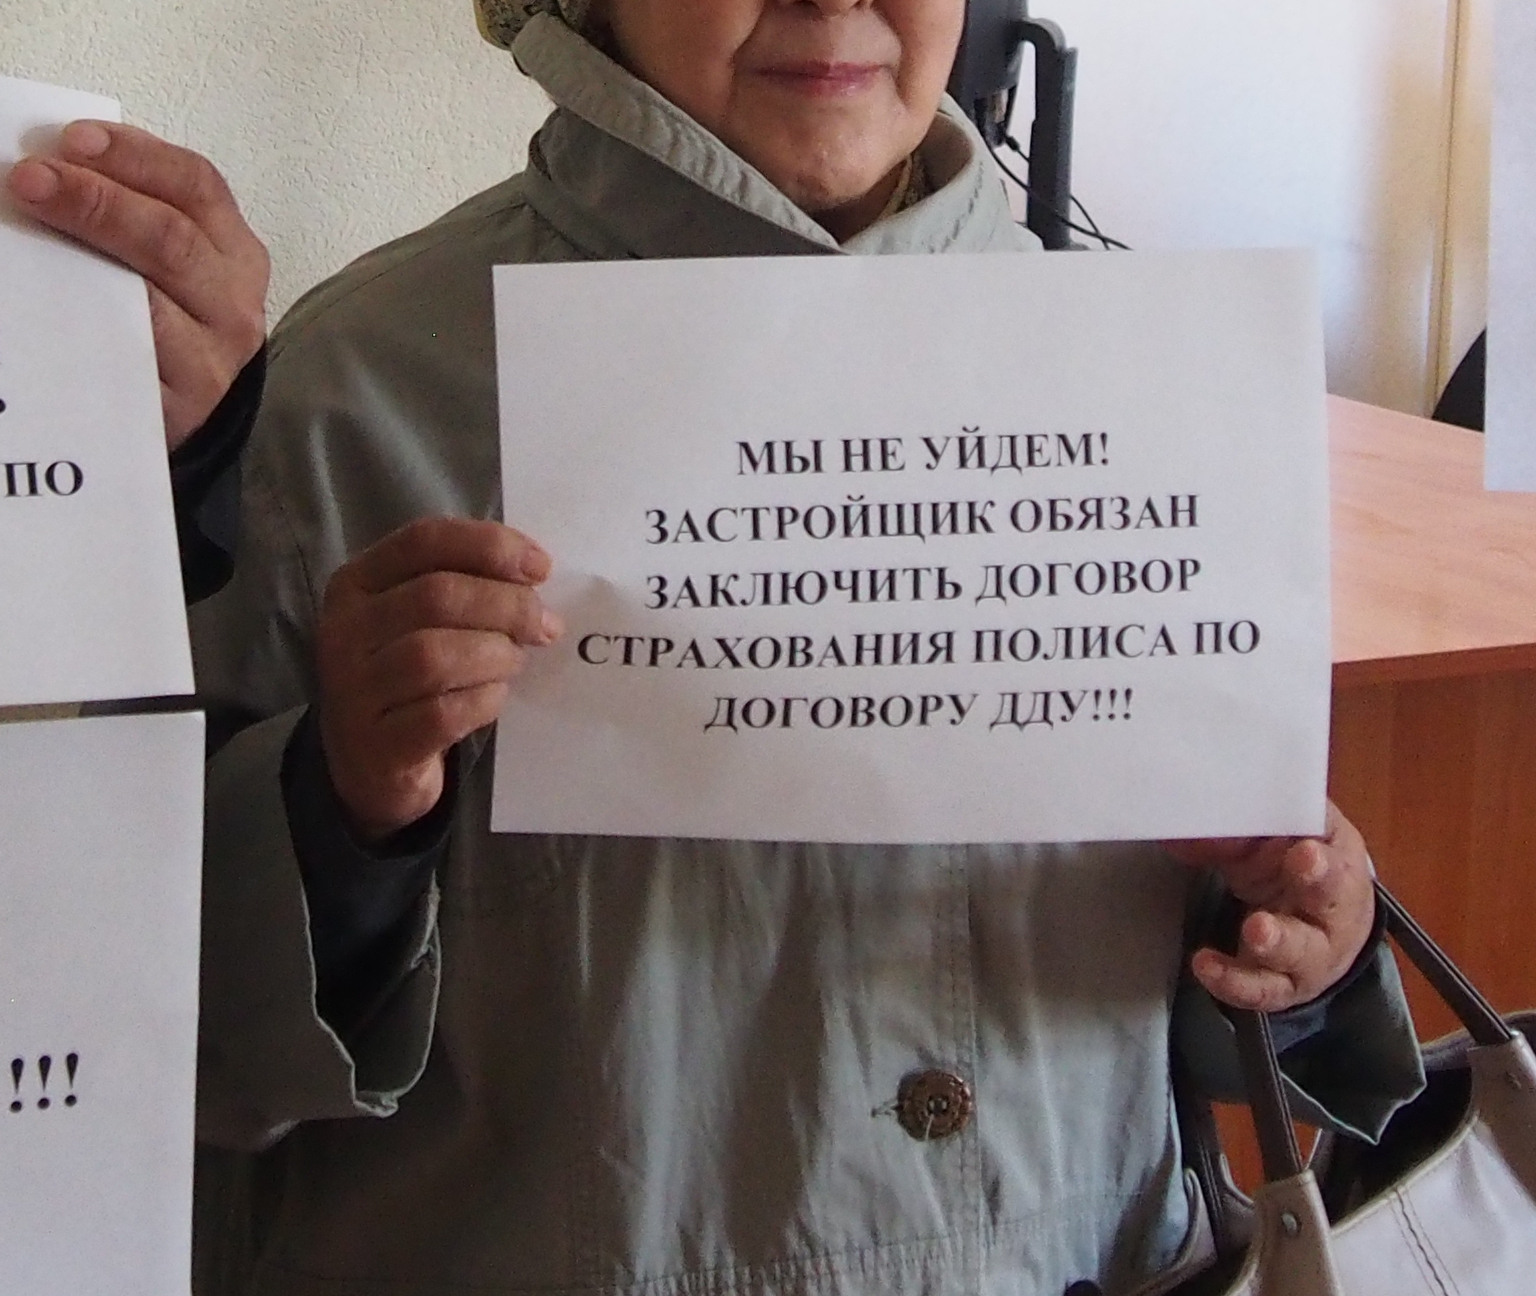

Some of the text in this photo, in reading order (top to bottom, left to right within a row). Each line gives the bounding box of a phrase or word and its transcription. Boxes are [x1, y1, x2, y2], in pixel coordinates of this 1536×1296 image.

[738, 426, 1108, 475] МЫ НЕ УЙДЕМ!
[4, 461, 84, 497] ПО
[645, 494, 1197, 545] ЗАСТРОЙЩИК ОБЯЗАН
[645, 558, 1201, 610] ЗАКЛЮЧИТЬ ДОГОВОР
[576, 620, 1260, 669] СТРАХОВАНИЯ ПОЛИСА ПО
[703, 687, 1133, 734] ДОГОВОРУ ДДУ!!!
[10, 1052, 79, 1113] !!!
